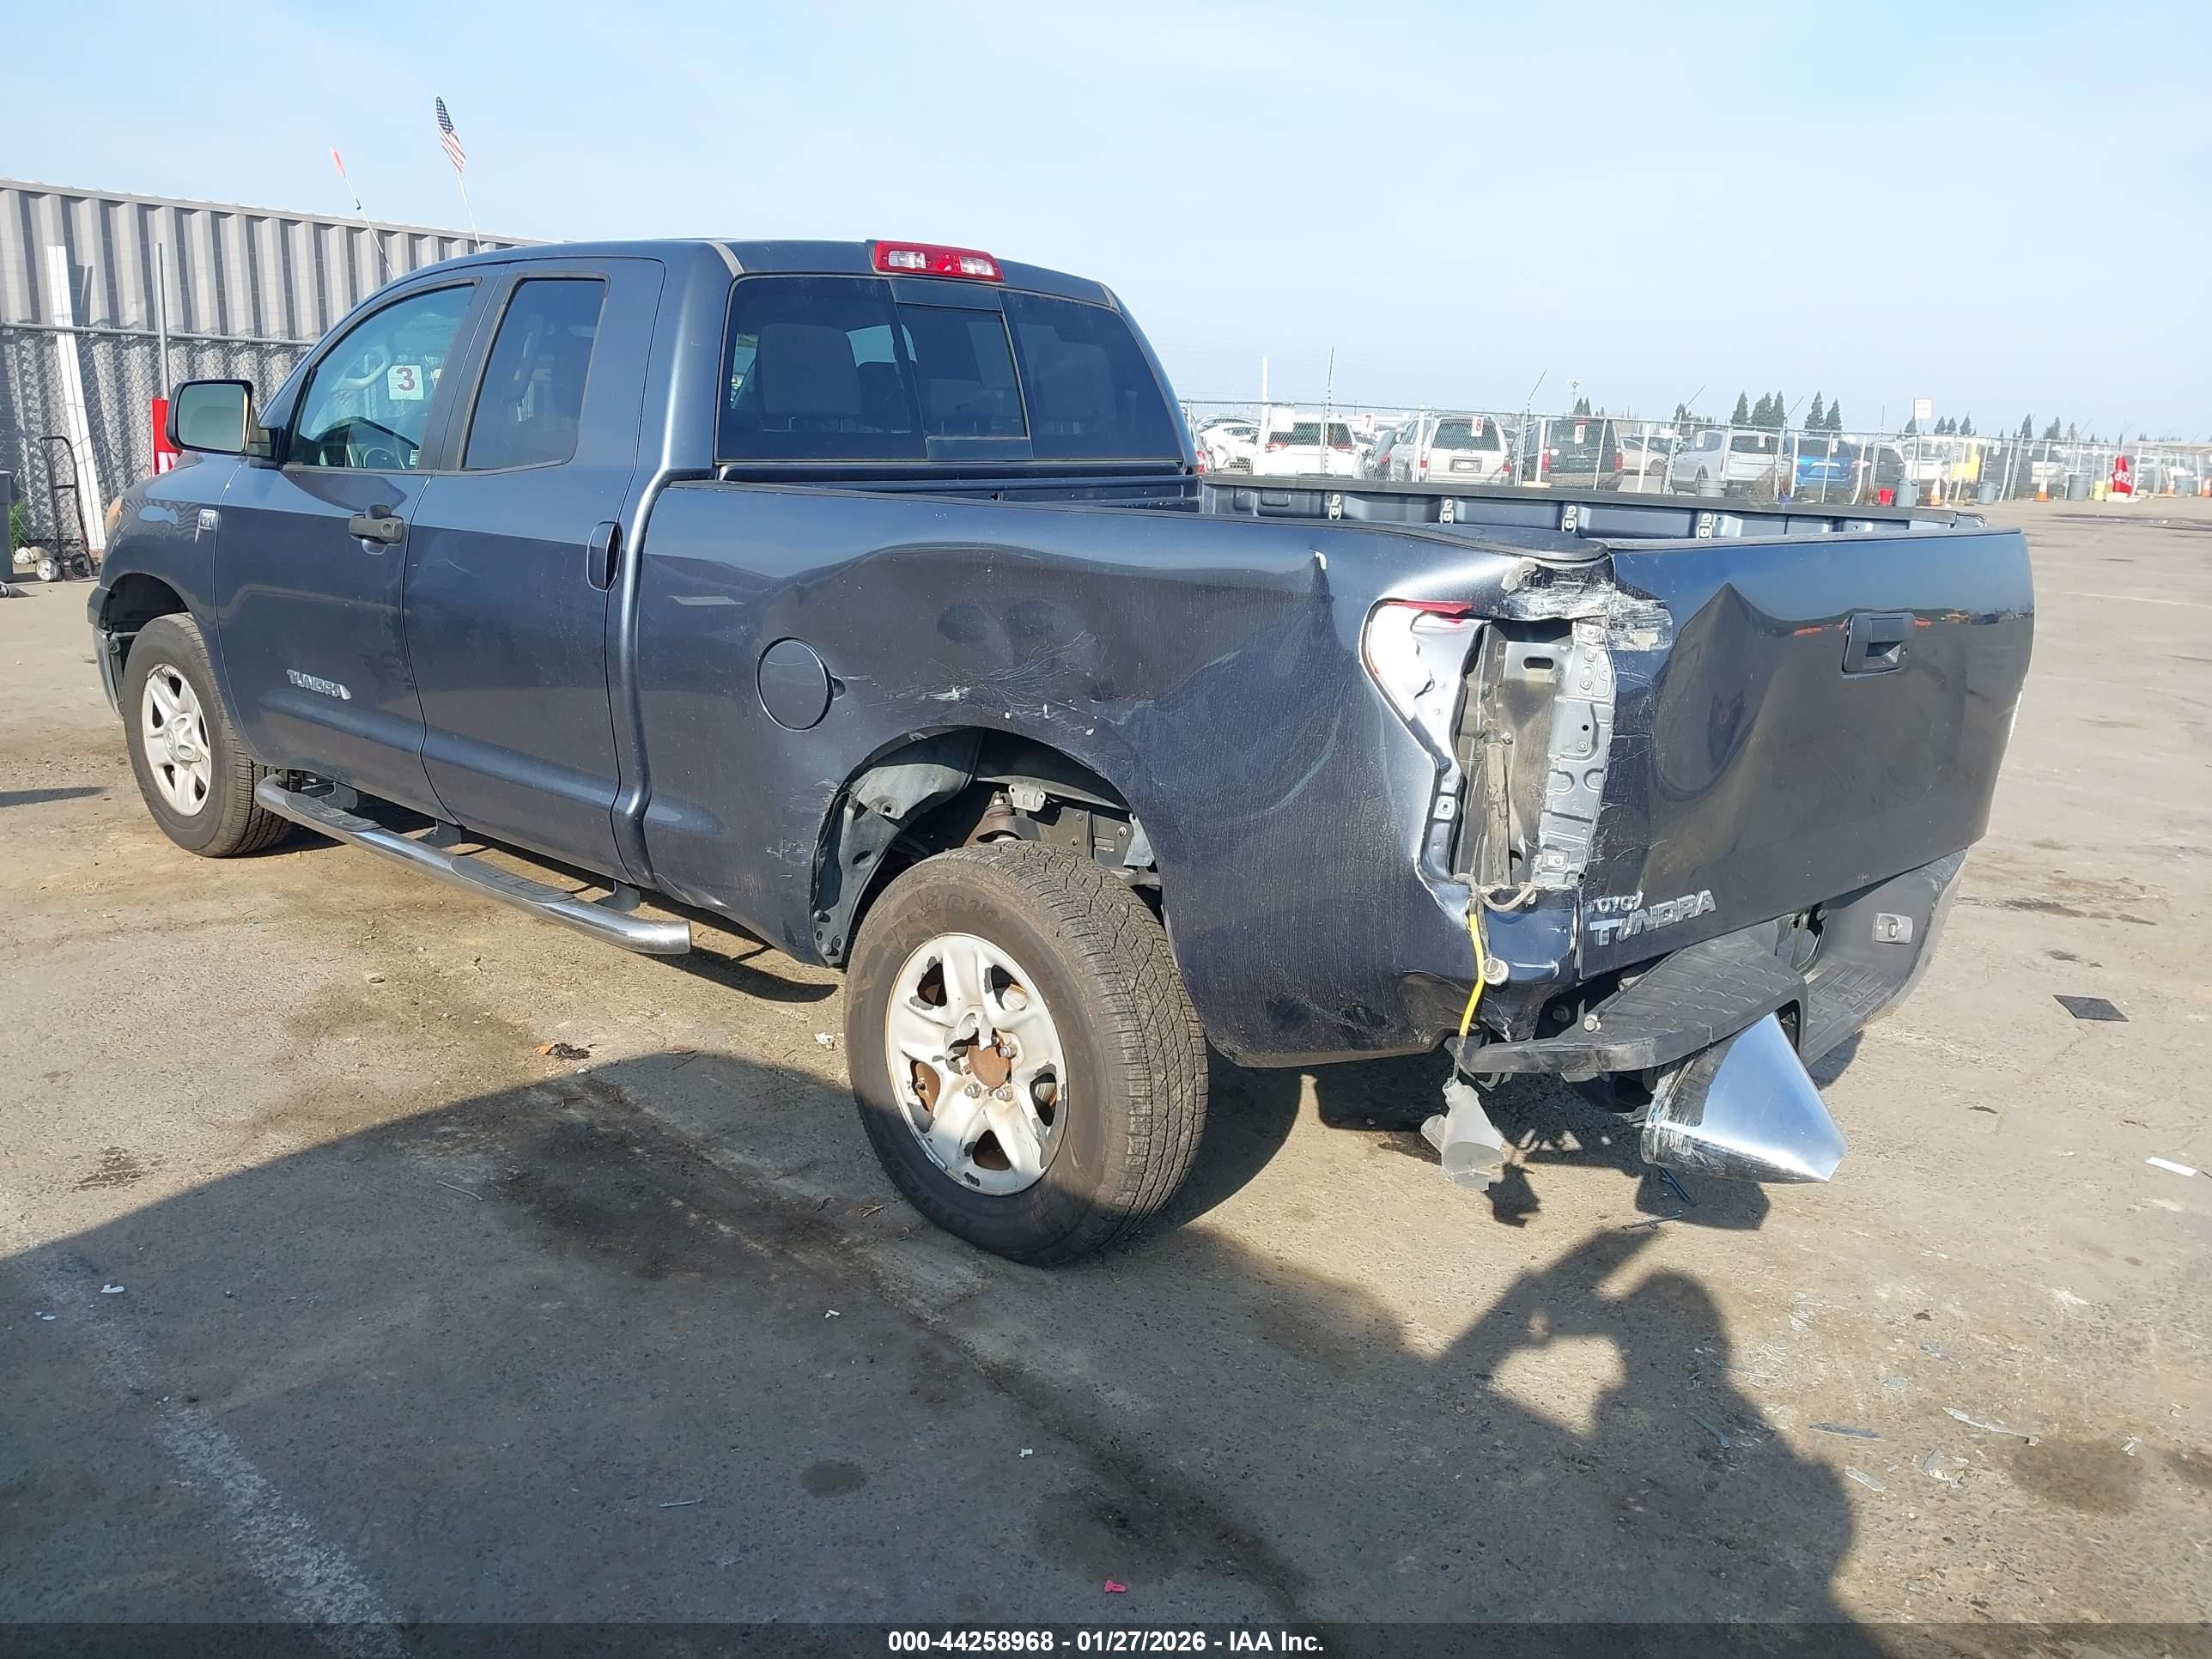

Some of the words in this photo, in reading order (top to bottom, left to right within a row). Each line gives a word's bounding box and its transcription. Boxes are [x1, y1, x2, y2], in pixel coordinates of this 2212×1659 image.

[397, 367, 416, 391] 3
[1365, 415, 1371, 428] 7
[1476, 418, 1481, 431] 8
[286, 669, 352, 700] TUNDRA
[1589, 889, 1717, 946] TUNDRA
